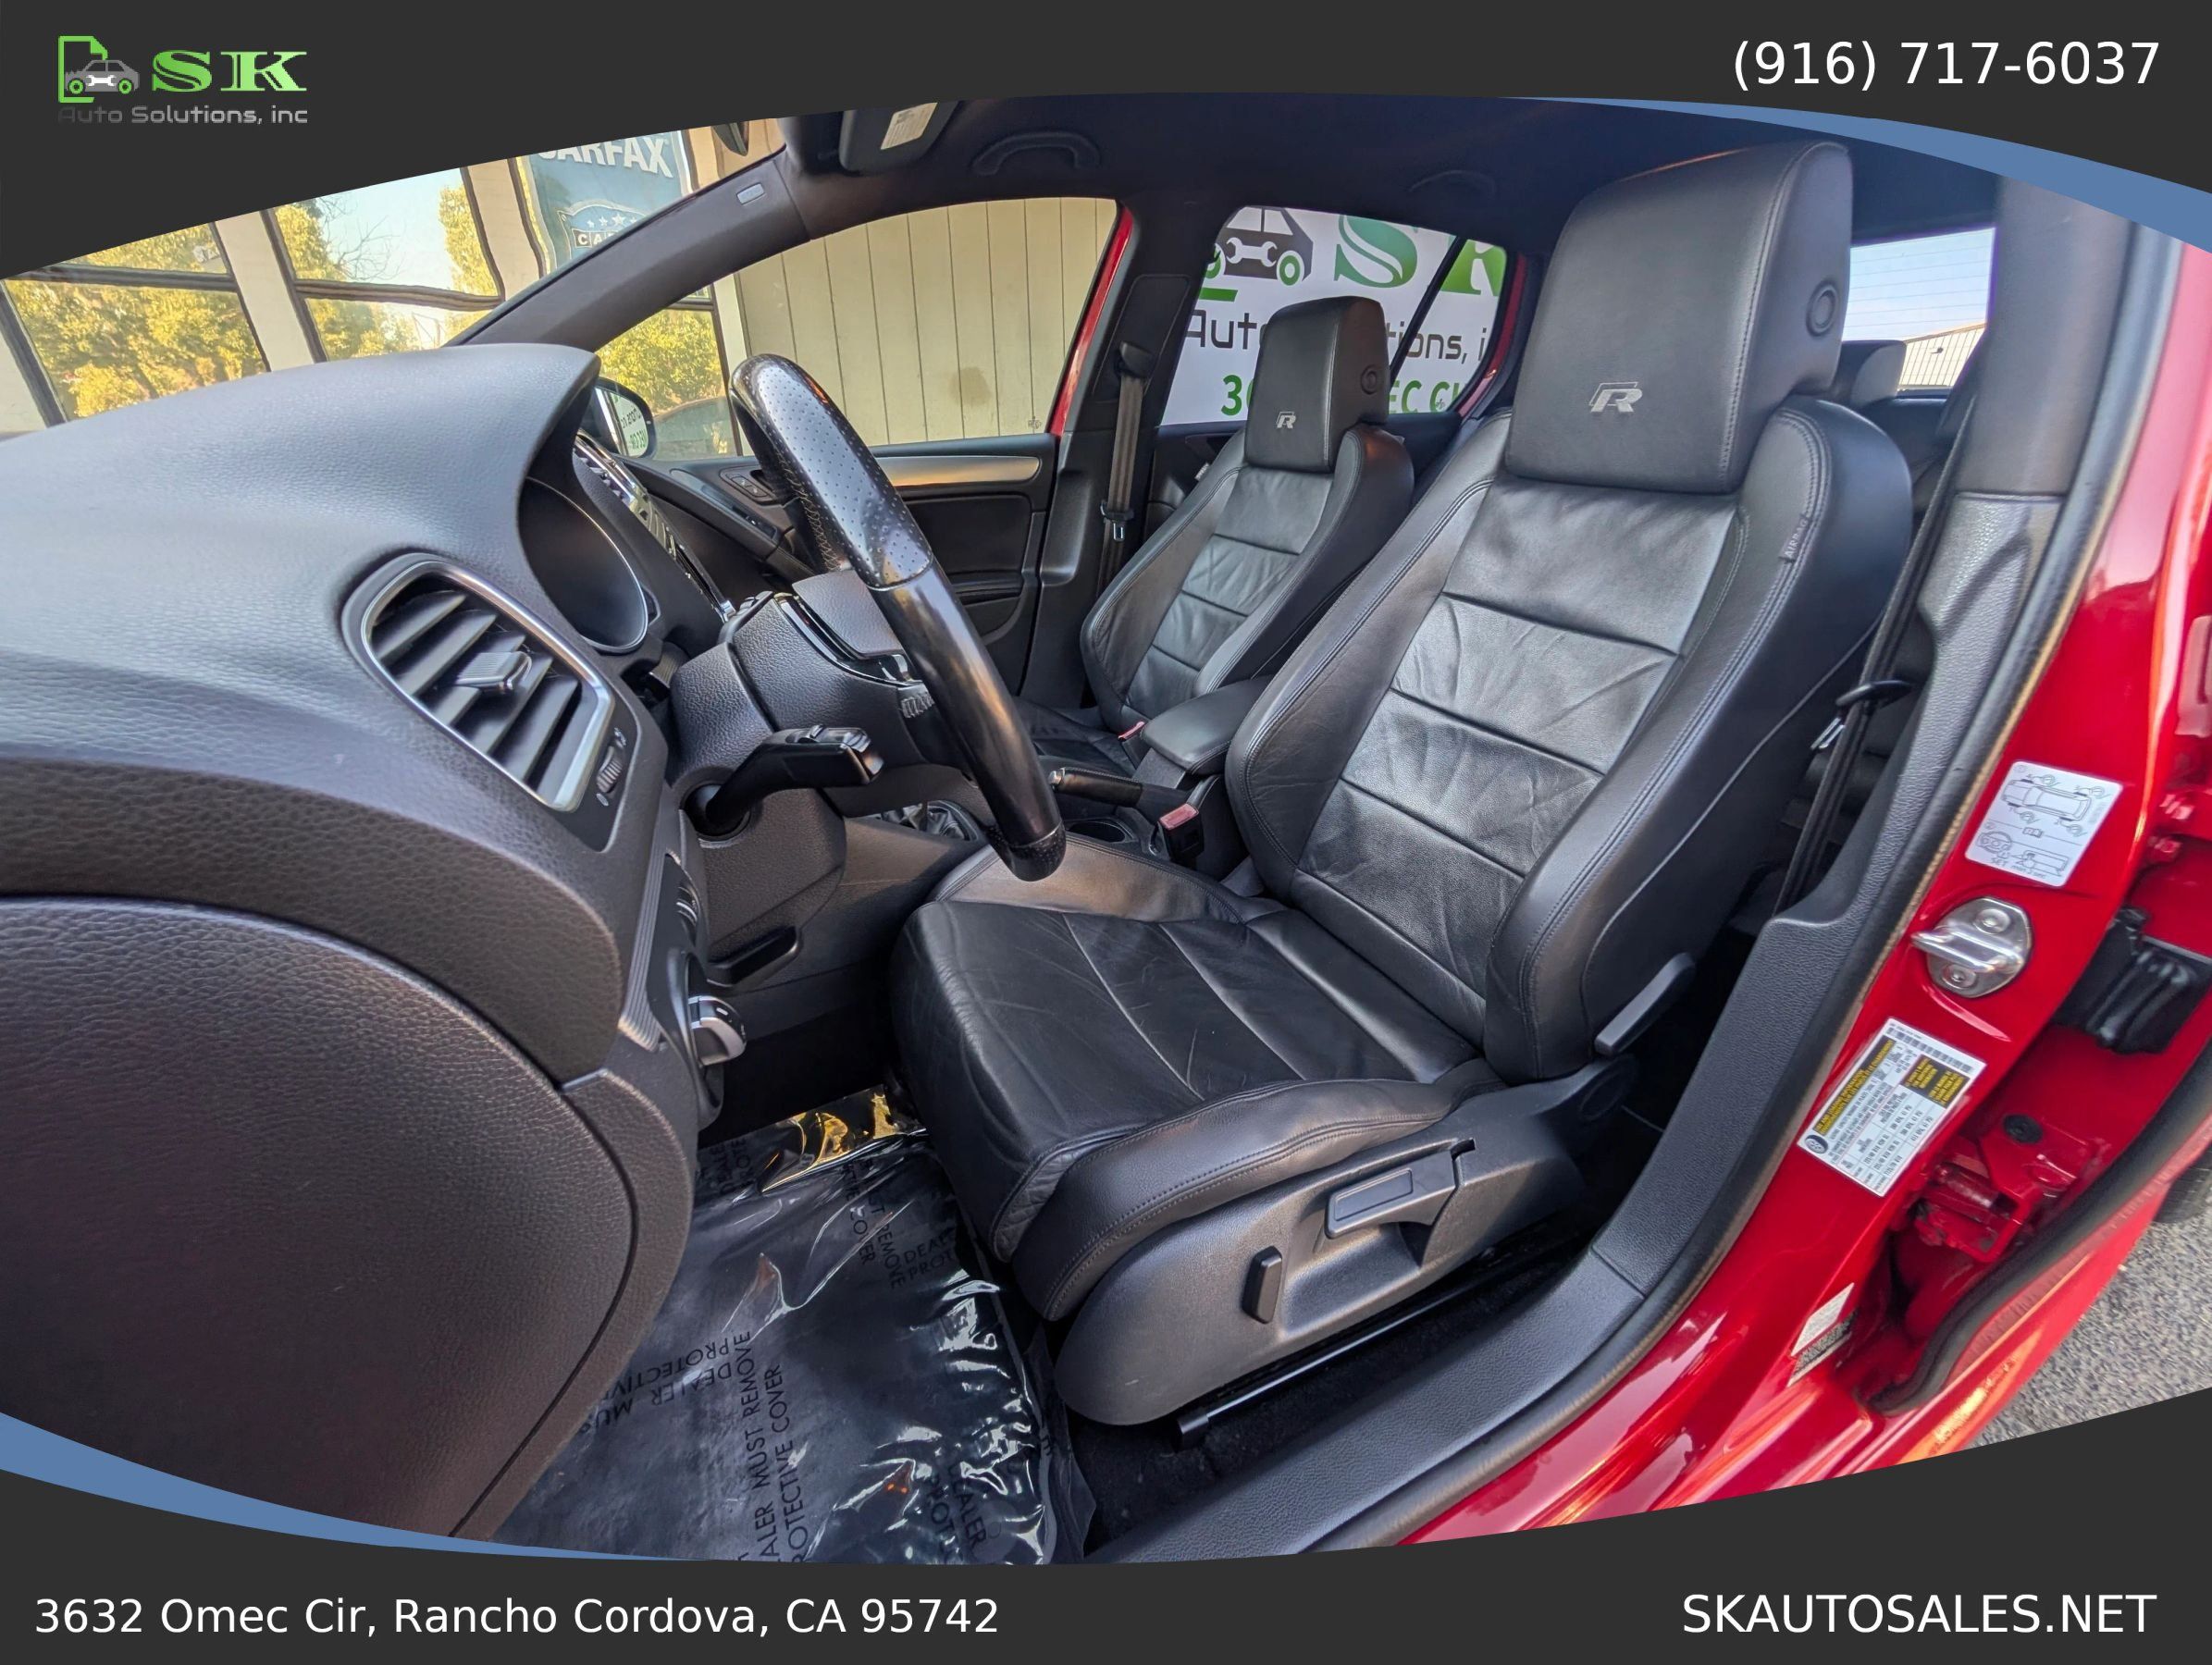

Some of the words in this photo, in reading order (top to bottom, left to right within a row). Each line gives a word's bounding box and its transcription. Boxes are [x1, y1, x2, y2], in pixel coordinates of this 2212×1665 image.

[539, 137, 673, 179] ARFAX
[1185, 309, 1266, 350] Aut
[1588, 381, 1643, 413] R
[1276, 411, 1297, 429] R
[1784, 518, 1809, 558] AIRBAG
[650, 1362, 732, 1406] DEALER
[734, 1331, 760, 1418] REMOVE
[764, 1364, 790, 1434] COVER
[745, 1427, 770, 1491] MUST
[755, 1501, 780, 1561] ALER
